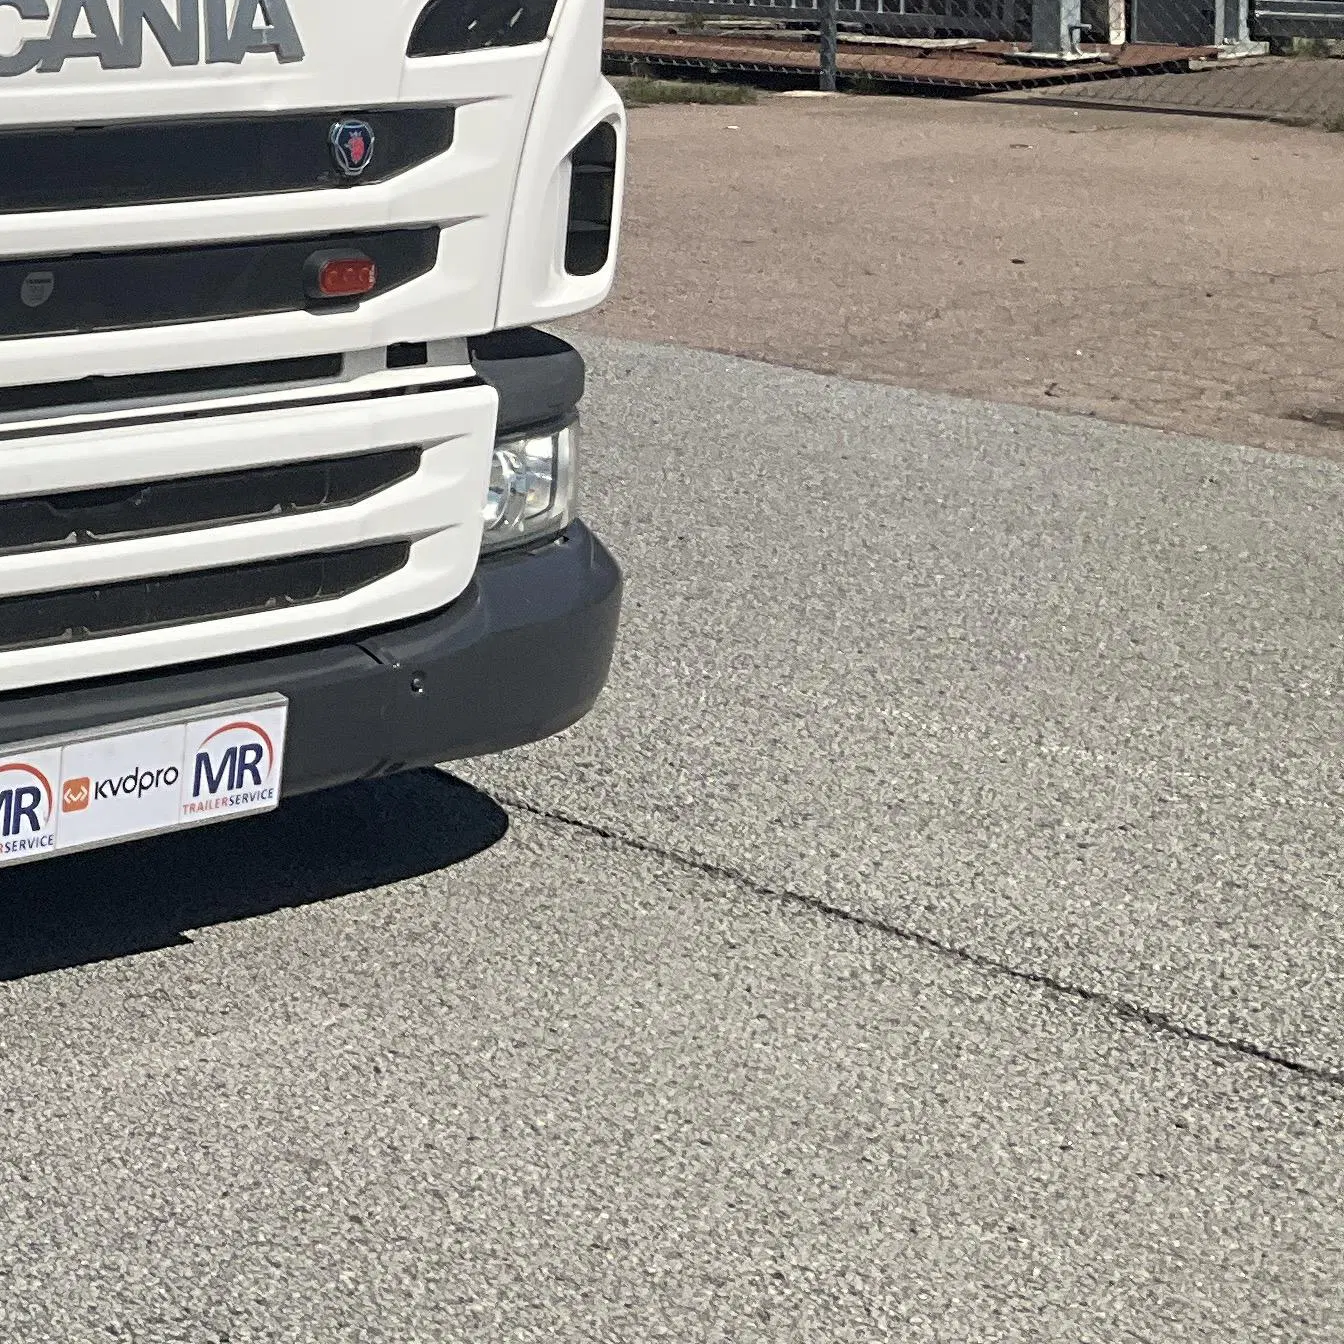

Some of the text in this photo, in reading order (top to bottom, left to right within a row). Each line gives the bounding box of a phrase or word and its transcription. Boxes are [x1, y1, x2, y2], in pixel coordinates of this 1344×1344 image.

[94, 765, 179, 799] kvdpro
[192, 743, 263, 797] MR
[183, 788, 274, 815] TRAILERSERVICE
